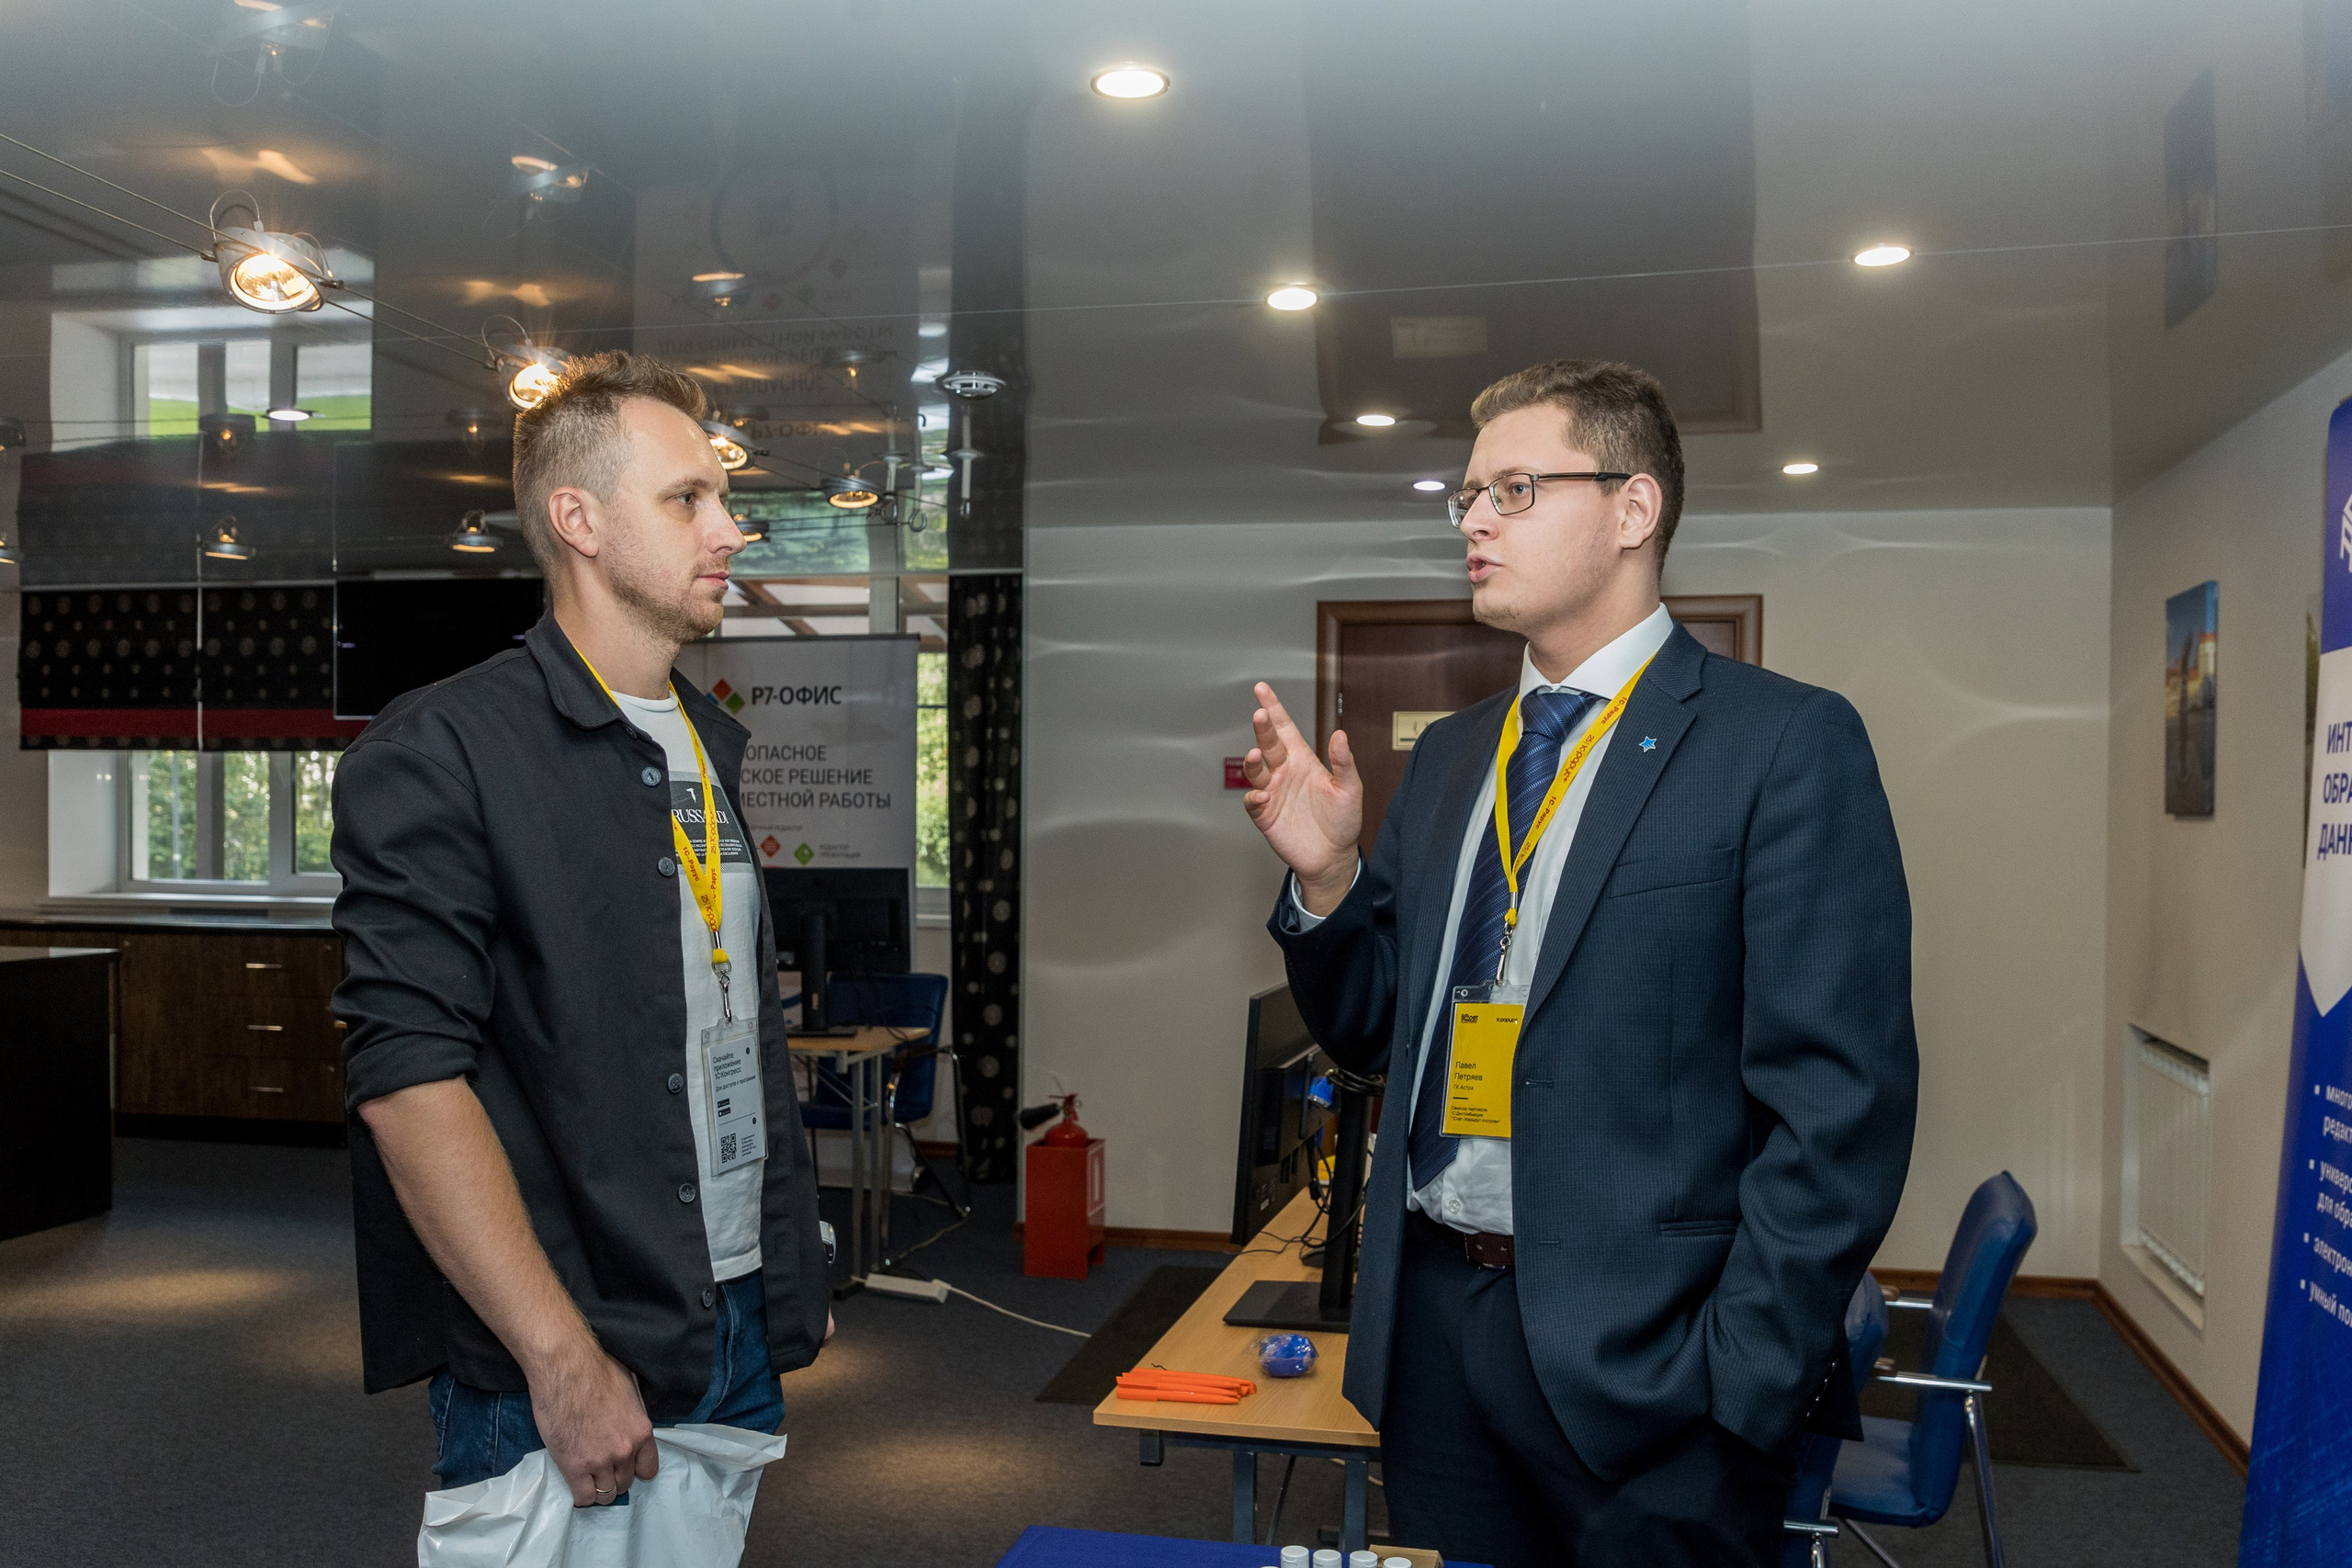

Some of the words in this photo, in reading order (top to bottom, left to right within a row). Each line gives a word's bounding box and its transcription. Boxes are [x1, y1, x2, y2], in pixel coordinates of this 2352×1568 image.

[752, 685, 842, 705] Р7-ОФИС
[2326, 721, 2352, 754] ИНТ
[745, 745, 827, 761] ОПАСНОЕ
[741, 769, 785, 784] СКОЕ
[788, 769, 874, 784] РЕШЕНИЕ
[741, 788, 814, 808] ЕСТНОЙ
[820, 793, 891, 808] РАБОТЫ
[713, 1053, 734, 1064] Скачайте
[714, 1059, 741, 1073] приложение
[1455, 1061, 1476, 1070] Павел
[1454, 1072, 1483, 1081] Петряев
